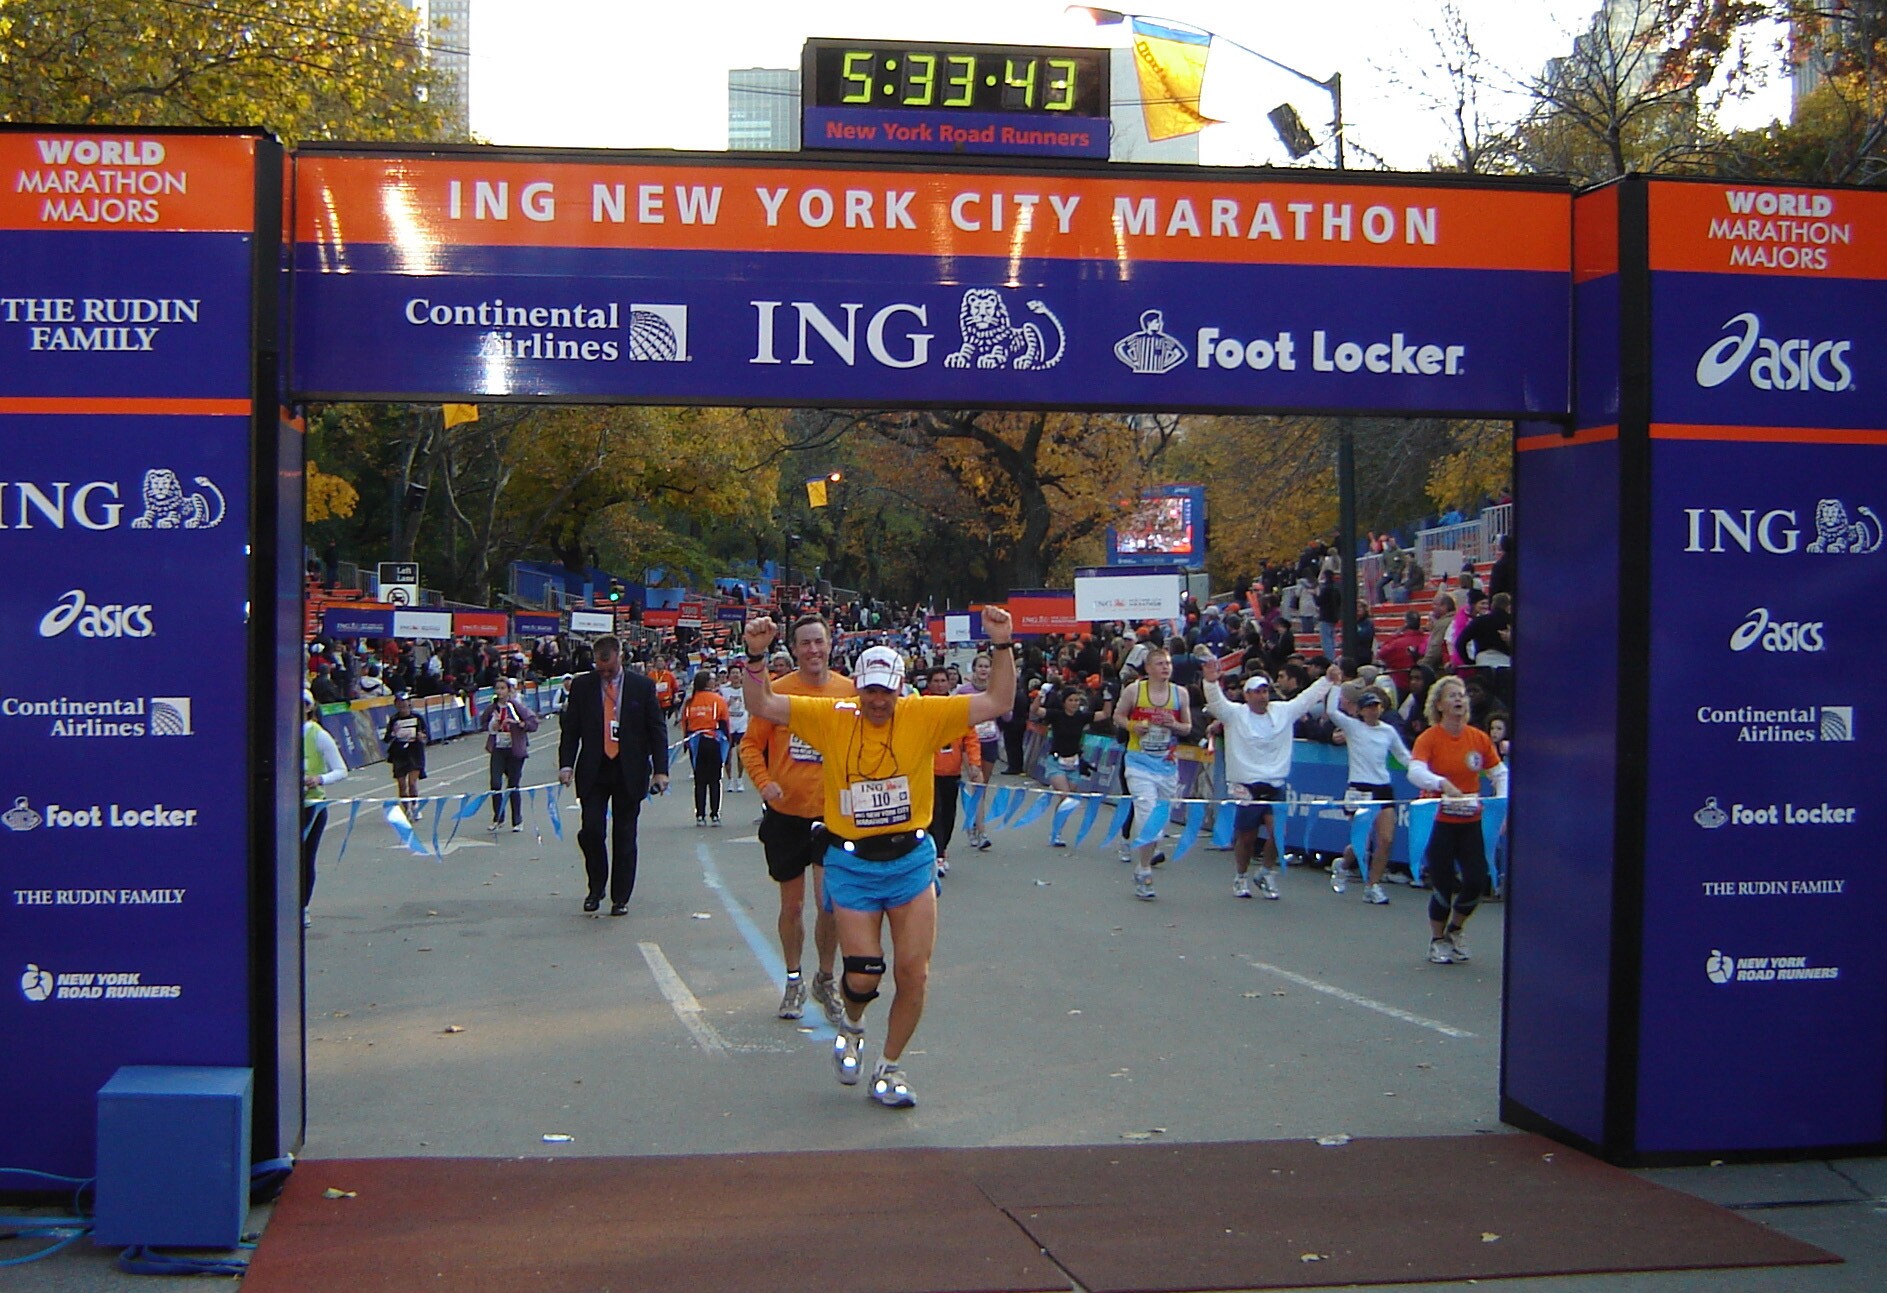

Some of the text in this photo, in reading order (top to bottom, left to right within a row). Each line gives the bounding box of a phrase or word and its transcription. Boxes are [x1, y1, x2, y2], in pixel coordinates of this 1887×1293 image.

[826, 121, 1090, 147] New York Road Runners
[37, 140, 166, 166] WORLD
[17, 170, 187, 195] MARATHON
[42, 198, 160, 223] MAJORS
[449, 180, 1437, 246] ING NEW YORK CITY MARATHON
[1725, 190, 1832, 218] WORLD
[1708, 218, 1851, 245] MARATHON
[1729, 245, 1828, 270] MAJORS
[1, 298, 201, 323] THE RUDIN
[405, 298, 620, 330] Continental
[30, 326, 160, 351] FAMILY
[478, 332, 620, 361] Airlines
[749, 300, 935, 369] ING
[1197, 327, 1465, 375] Foot Locker
[1749, 338, 1852, 392] asics
[1683, 508, 1801, 554] ING
[77, 604, 153, 638] asics
[1761, 621, 1824, 652] asics
[1, 697, 145, 716] Continental
[1697, 705, 1816, 723] Continental
[50, 718, 145, 737] Airlines
[1737, 725, 1816, 742] Airlines
[861, 783, 883, 793] ING
[872, 792, 890, 807] 110
[46, 804, 197, 828] Foot Locker
[1731, 802, 1856, 825] Foot Locker
[13, 888, 186, 905] THE RUDIN FAMILY
[1702, 880, 1845, 896] THE RUDIN FAMILY
[1736, 956, 1807, 969] NEW YORK
[1736, 967, 1840, 981] ROAD RUNNERS
[56, 973, 141, 985] NEW YORK
[56, 985, 182, 999] ROAD RUNNERS
